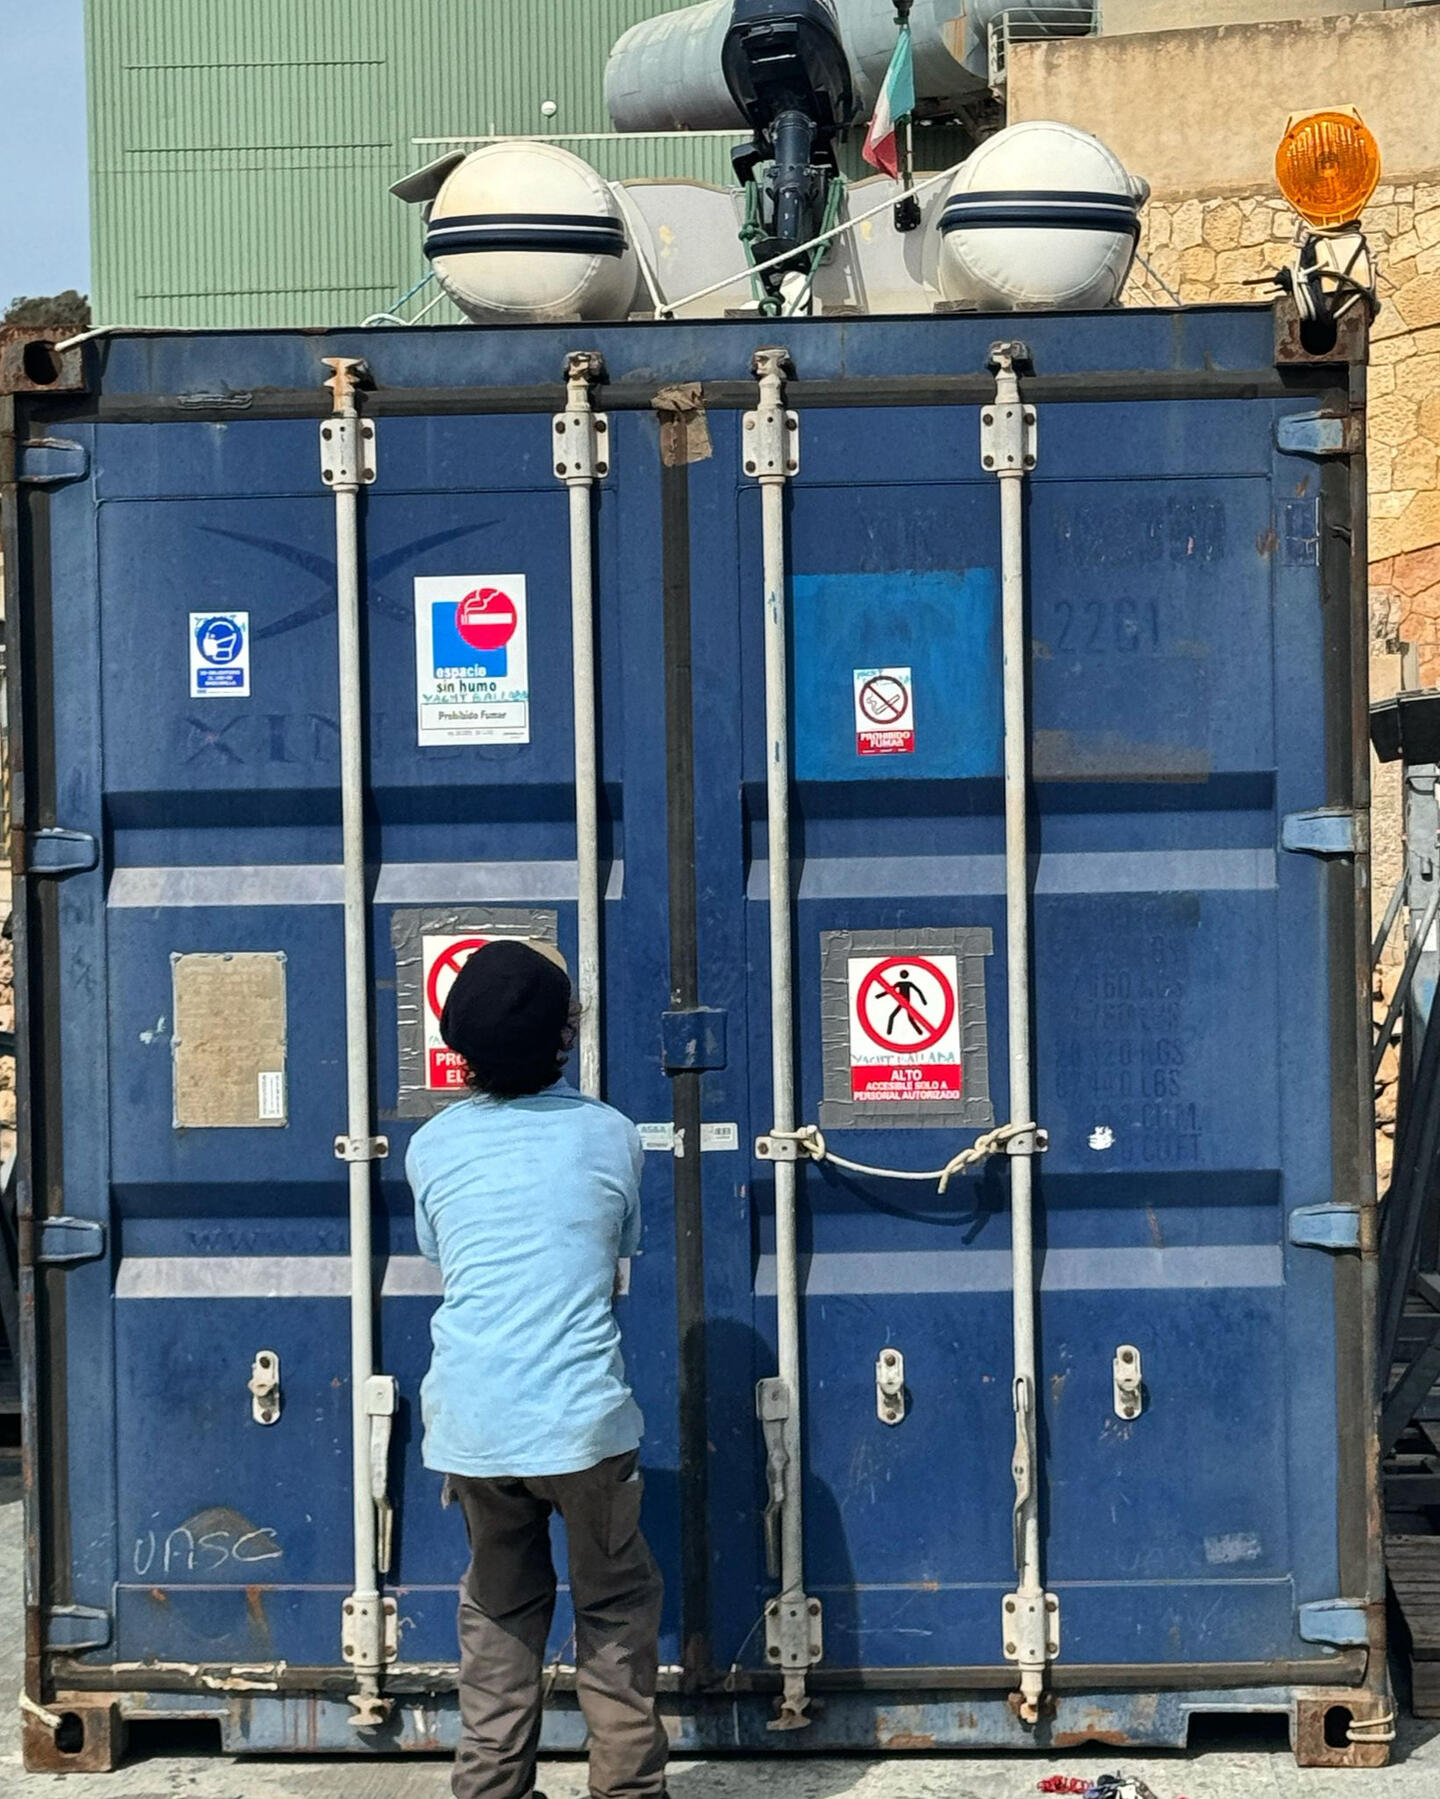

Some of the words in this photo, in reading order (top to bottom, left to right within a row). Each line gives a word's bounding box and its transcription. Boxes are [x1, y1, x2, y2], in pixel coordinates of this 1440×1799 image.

[436, 665, 487, 679] espacio
[436, 681, 455, 693] sin
[459, 679, 497, 693] humo
[438, 710, 478, 720] Prohibido
[480, 709, 507, 720] Fumar
[869, 739, 905, 749] FUMAR
[890, 1069, 923, 1081] ALTO
[865, 1081, 913, 1091] ACCESIBLE
[914, 1081, 939, 1090] SOLO
[940, 1080, 949, 1090] A
[853, 1092, 901, 1101] PERSONAL
[902, 1090, 960, 1101] AUTORIZADO
[133, 1526, 284, 1575] UASC
